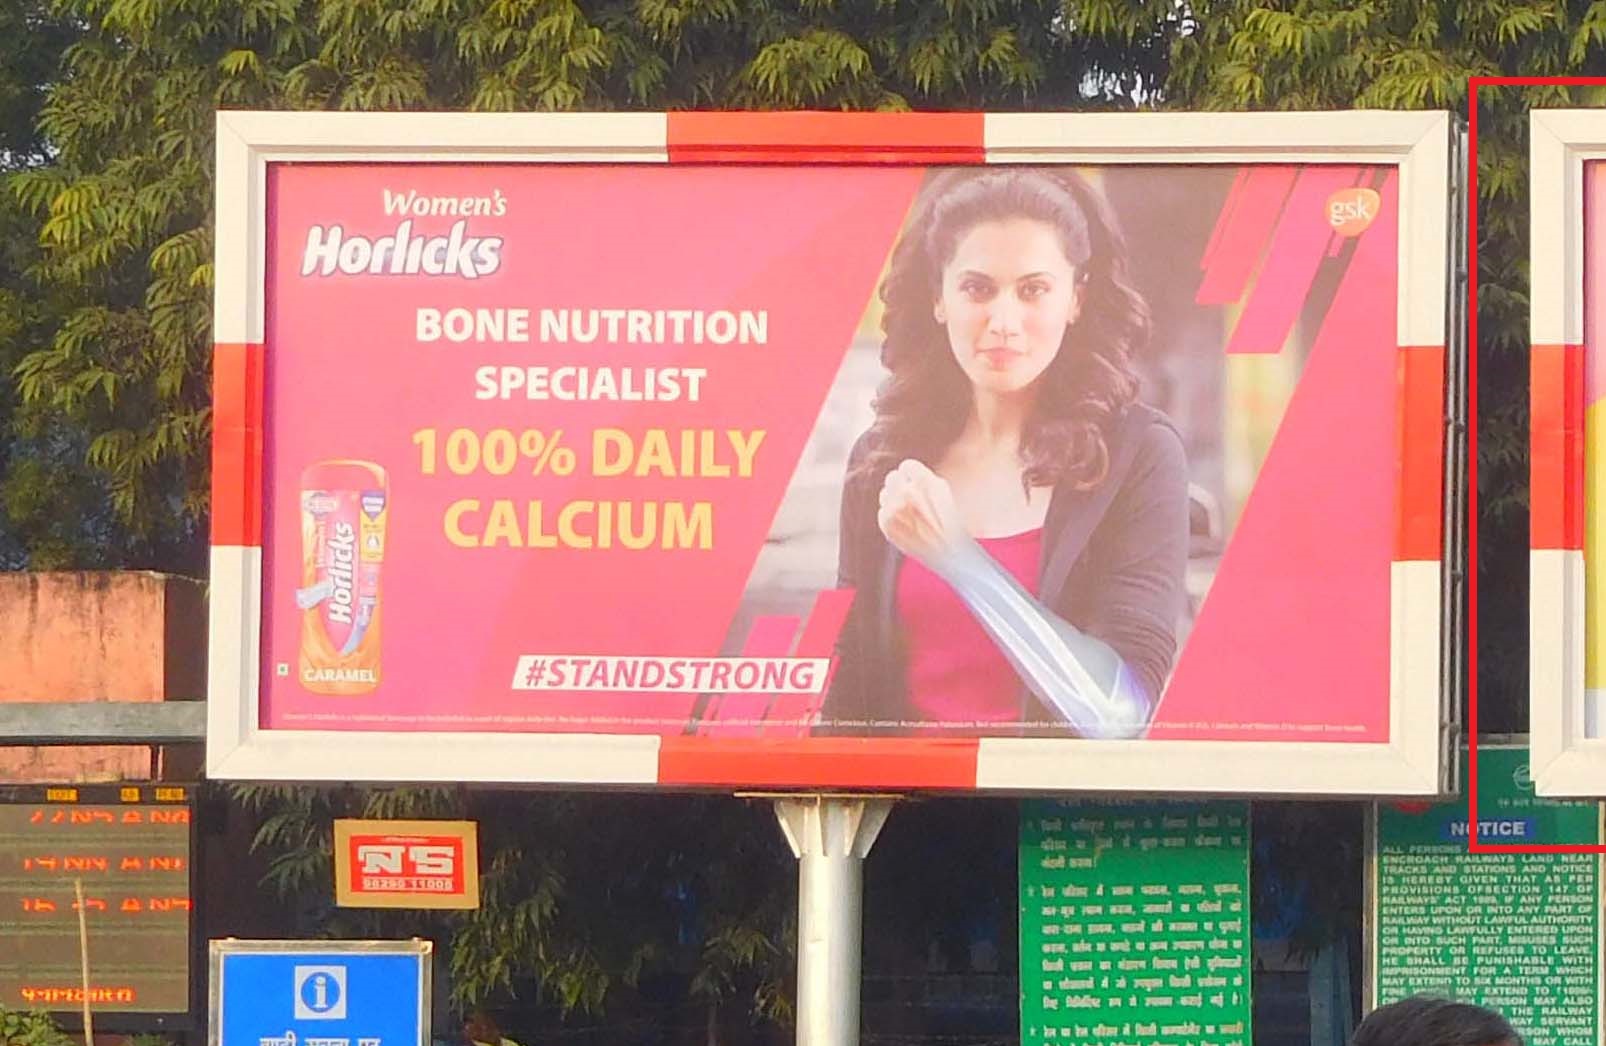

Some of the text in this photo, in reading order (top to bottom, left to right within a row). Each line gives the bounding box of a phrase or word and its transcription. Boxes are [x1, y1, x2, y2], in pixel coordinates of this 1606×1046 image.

[383, 188, 507, 217] Women's
[1329, 191, 1374, 226] gsk
[302, 220, 503, 279] Horlicks
[416, 307, 768, 345] BONE NUTRITION
[474, 366, 707, 402] SPECIALIST
[412, 427, 767, 479] 100% DAILY
[443, 498, 713, 550] CALCIUM
[327, 521, 355, 625] Horlicks
[303, 667, 377, 683] CARAMEL
[525, 658, 815, 691] #STANDSTRONG
[1450, 821, 1526, 836] NTICE
